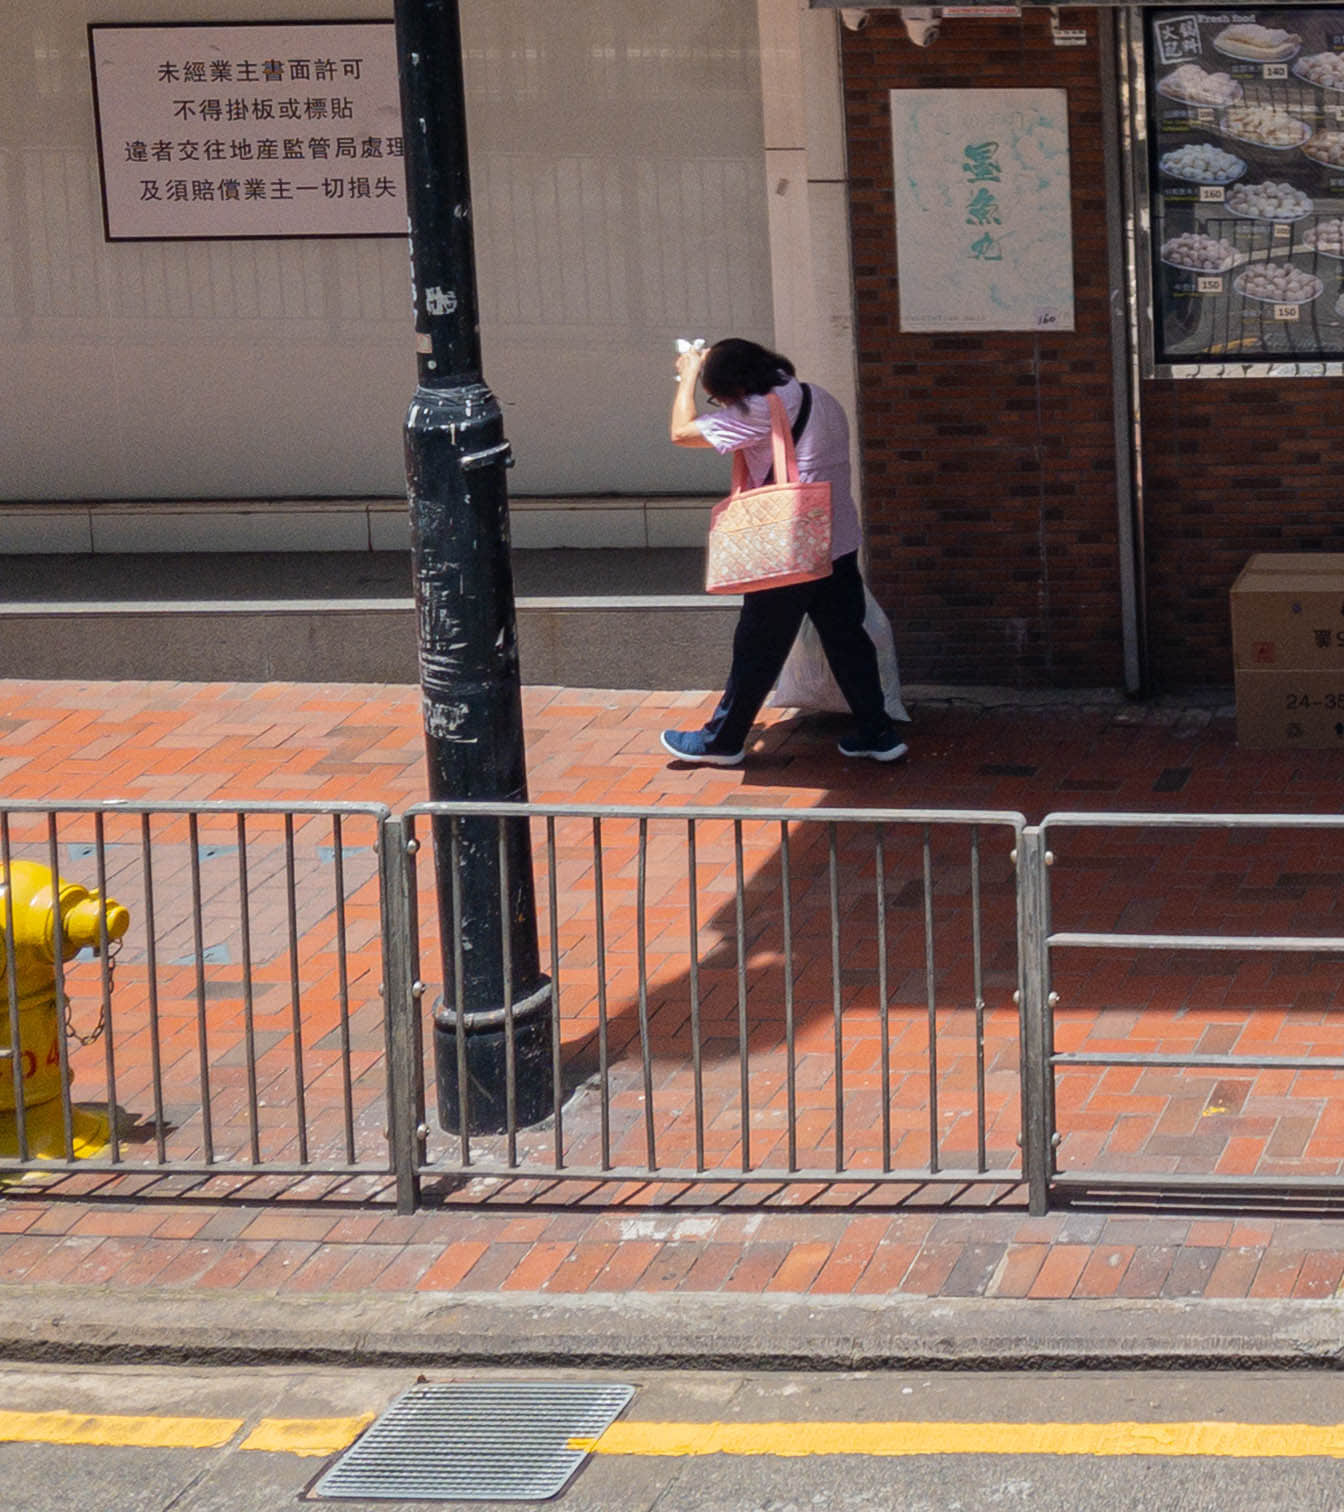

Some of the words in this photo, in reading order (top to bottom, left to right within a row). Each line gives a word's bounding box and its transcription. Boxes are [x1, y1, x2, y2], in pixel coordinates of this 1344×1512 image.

[1199, 14, 1230, 23] Fresh
[1232, 14, 1257, 23] food
[157, 58, 363, 84] 未經業主書面許可
[172, 96, 354, 122] 不得掛板或標貼
[139, 176, 397, 202] 及須賠償業主一切損失
[961, 141, 1004, 261] 墨魚丸
[1202, 281, 1220, 289] 150
[1278, 308, 1297, 317] 150
